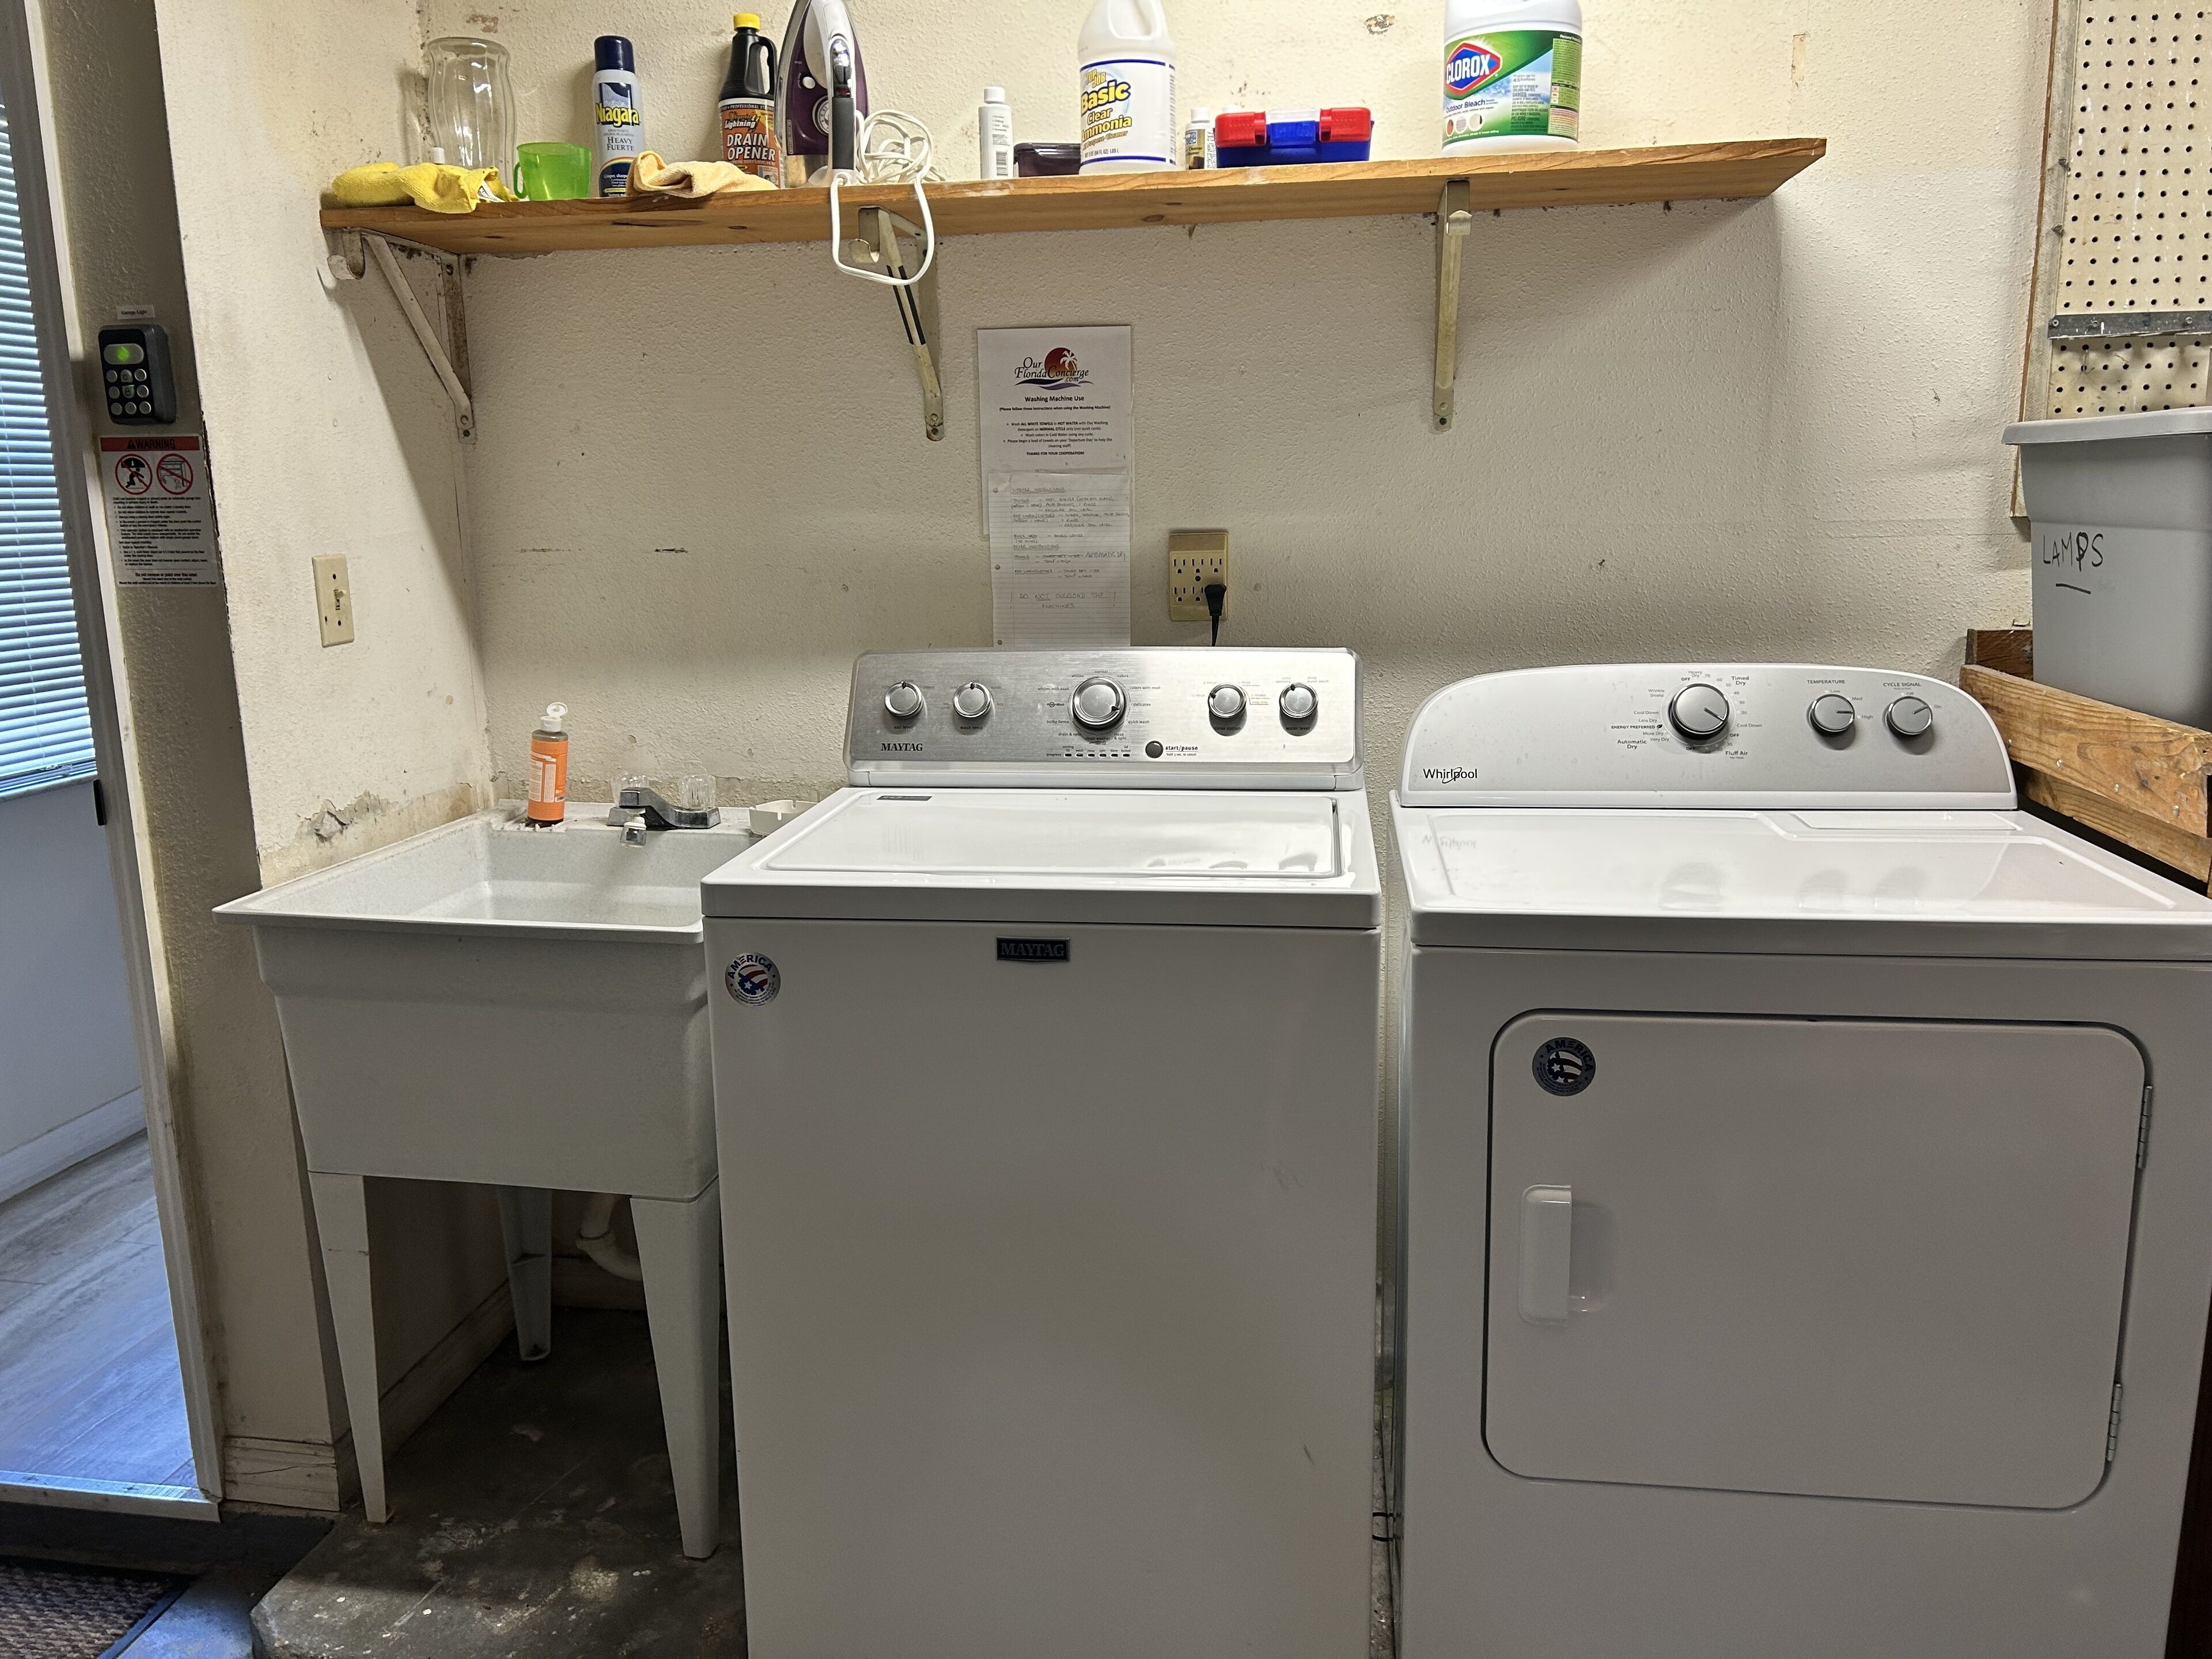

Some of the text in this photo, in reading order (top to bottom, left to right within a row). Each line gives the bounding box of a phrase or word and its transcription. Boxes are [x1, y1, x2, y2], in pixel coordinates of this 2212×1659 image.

[1086, 69, 1097, 82] TOP
[1446, 54, 1490, 84] CLOROX
[1093, 73, 1106, 88] JOB
[1081, 79, 1131, 116] Basic
[1446, 99, 1485, 113] Outdoor Bleach
[596, 103, 639, 127] Niagara
[1087, 108, 1112, 125] Clear
[725, 120, 756, 129] Lightning
[1081, 115, 1132, 142] Ammonia
[727, 133, 767, 146] DRAIN
[728, 147, 776, 160] OPENER
[1023, 357, 1043, 369] Our
[1014, 365, 1089, 379] Florida Concierge
[135, 439, 175, 449] WARNING
[2043, 531, 2103, 572] LAMPS
[881, 743, 923, 751] MAYTAG
[1423, 767, 1478, 783] Whirlpool
[1001, 943, 1065, 956] MAYTAG
[728, 955, 772, 979] AMERICA
[1546, 1040, 1593, 1071] AMERICA
